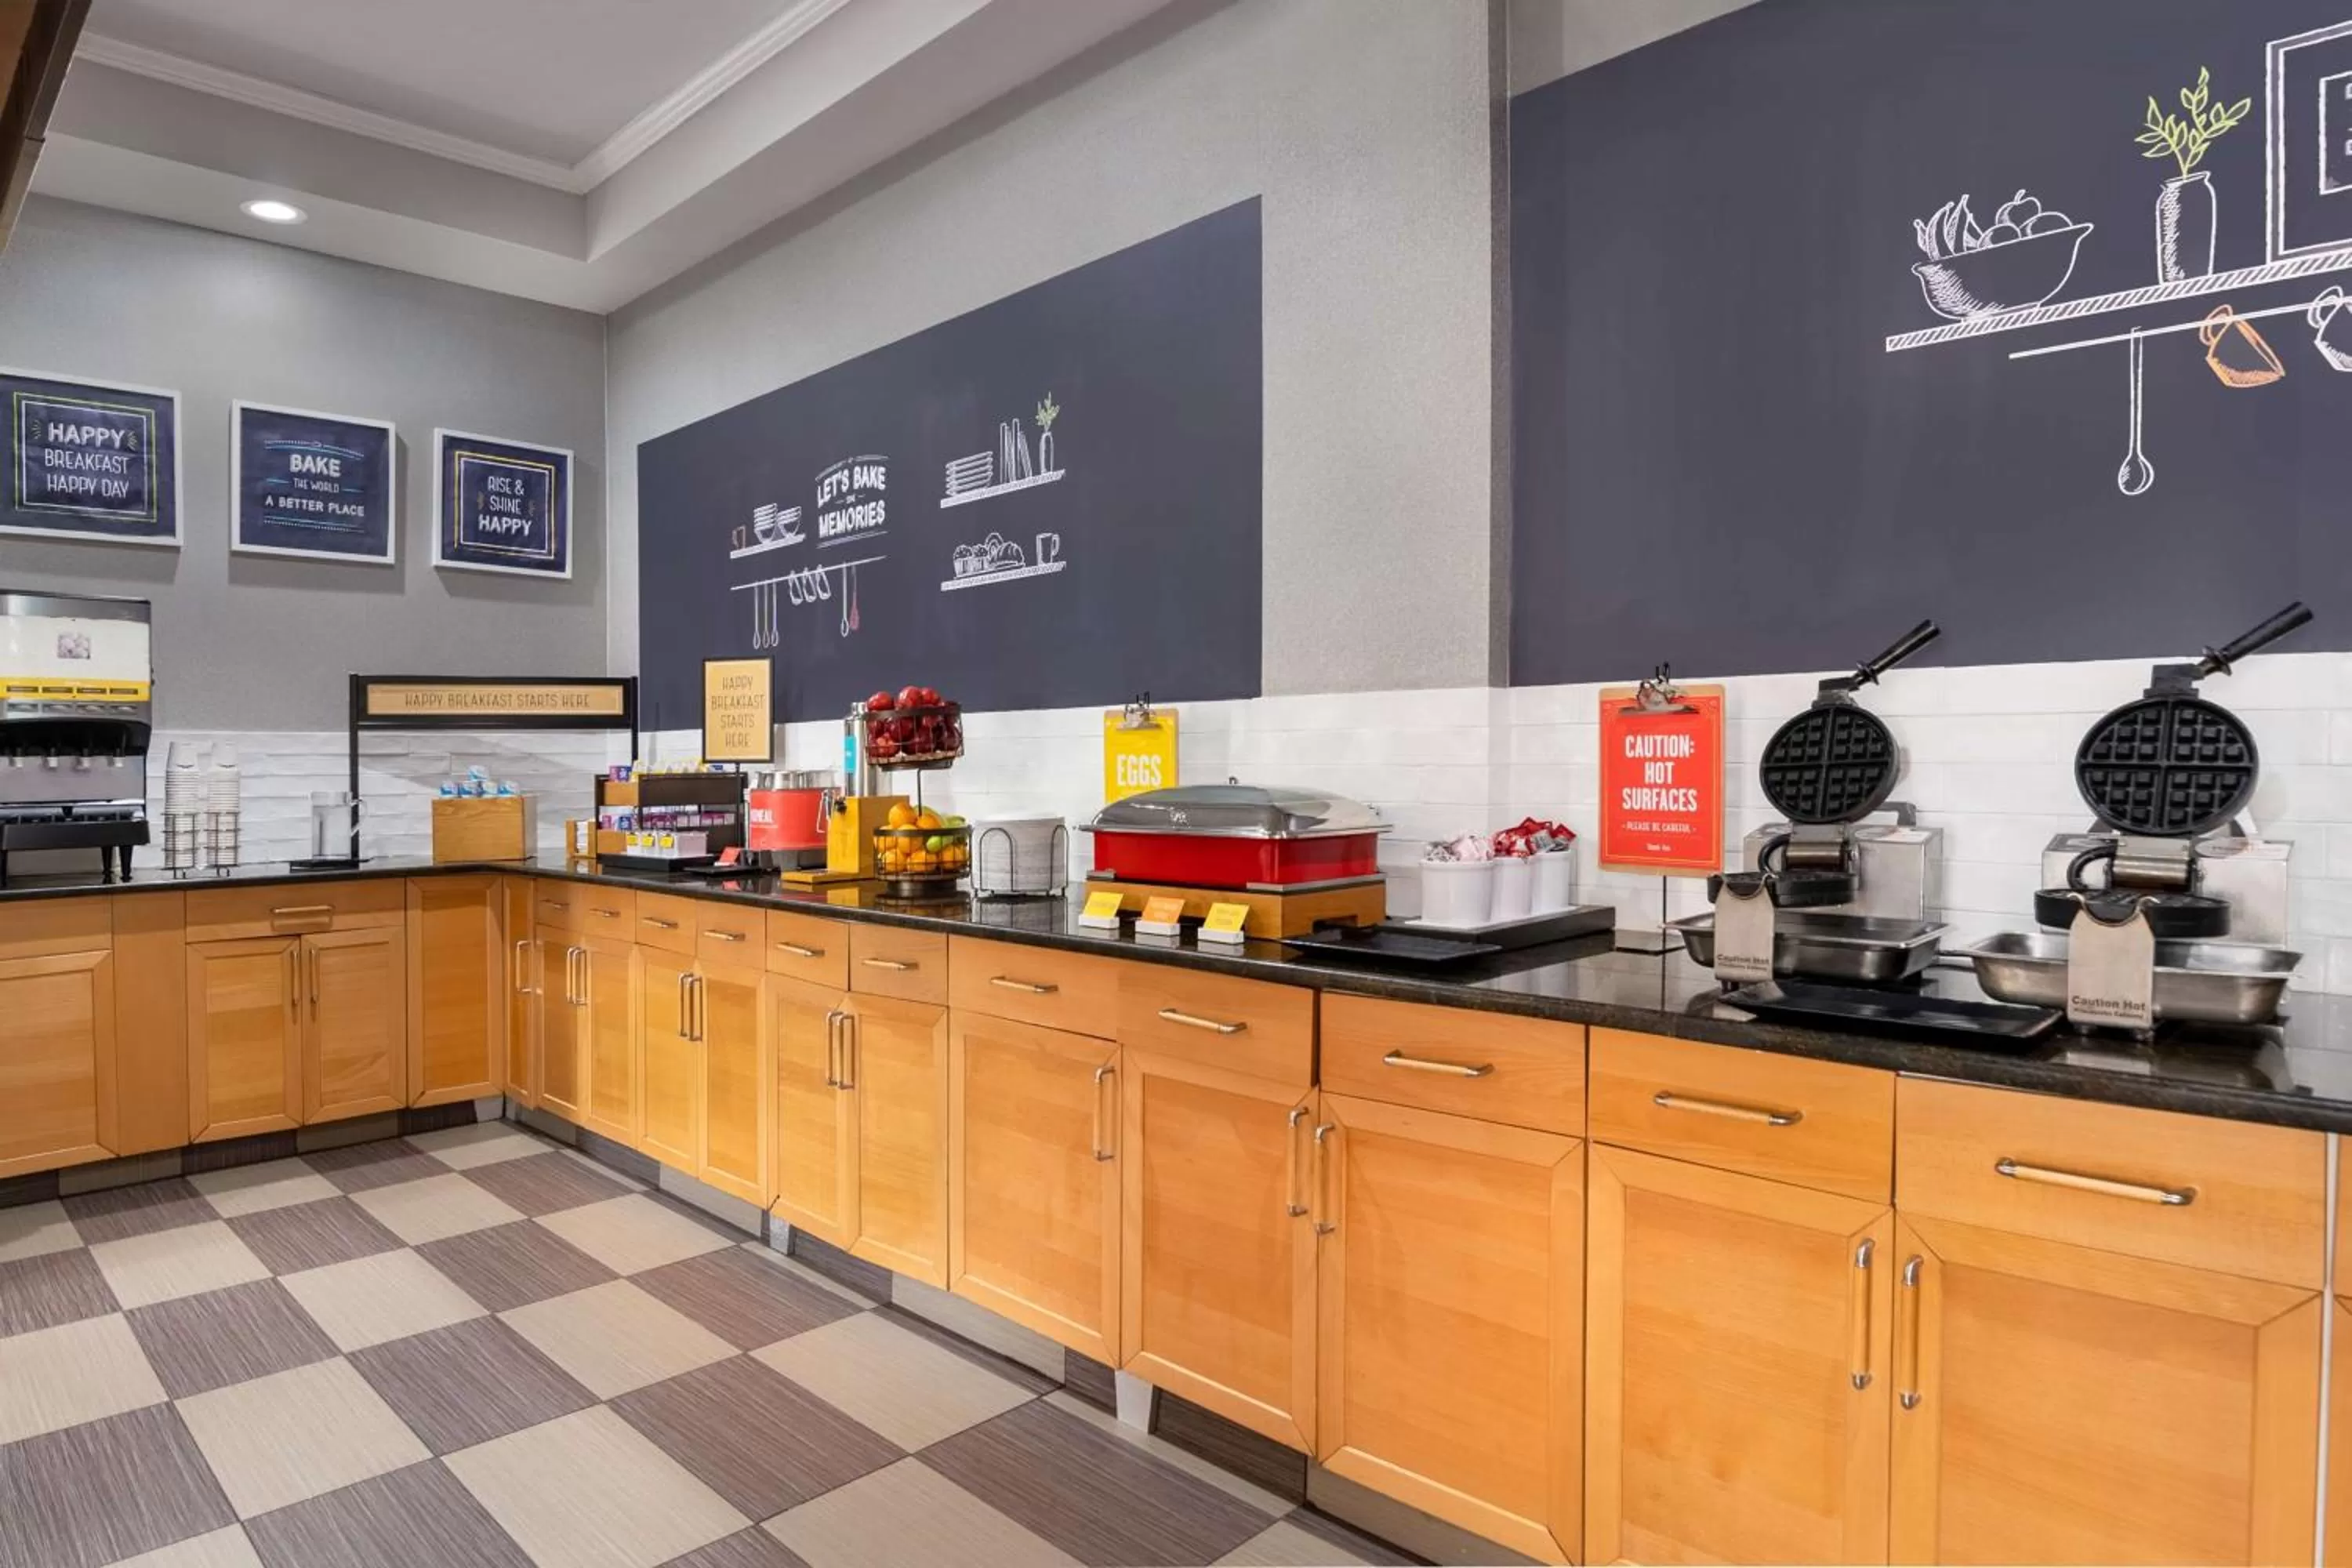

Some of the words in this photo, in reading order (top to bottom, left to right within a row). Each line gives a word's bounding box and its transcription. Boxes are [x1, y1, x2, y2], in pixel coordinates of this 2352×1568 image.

[48, 422, 125, 449] HAPPY
[45, 448, 129, 474] BREAKFAST
[289, 454, 341, 477] BAKE
[47, 474, 96, 495] HAPPY
[101, 479, 129, 499] DAY
[292, 477, 307, 490] THE
[310, 481, 339, 493] WORLD
[487, 476, 512, 494] RISE
[515, 480, 524, 495] &
[817, 469, 849, 508] LET'S
[853, 465, 886, 490] BAKE
[265, 495, 274, 506] A
[278, 497, 324, 512] BETTER
[328, 503, 365, 517] PLACE
[490, 495, 521, 515] SHINE
[478, 514, 532, 536] HAPPY
[818, 499, 885, 539] MEMORIES
[722, 675, 753, 691] HAPPY
[405, 692, 442, 708] HAPPY
[448, 692, 513, 709] BREAKFAST
[517, 693, 557, 708] STARTS
[562, 694, 590, 708] HERE
[711, 695, 765, 711] BREAKFAST
[720, 713, 755, 728] STARTS
[725, 731, 751, 748] HERE
[1624, 734, 1695, 758] CAUTION:
[1116, 753, 1162, 786] EGGS
[1644, 761, 1675, 785] HOT
[1622, 787, 1697, 812] SURFACES
[2071, 995, 2120, 1008] Caution
[2123, 1000, 2145, 1011] Hot
